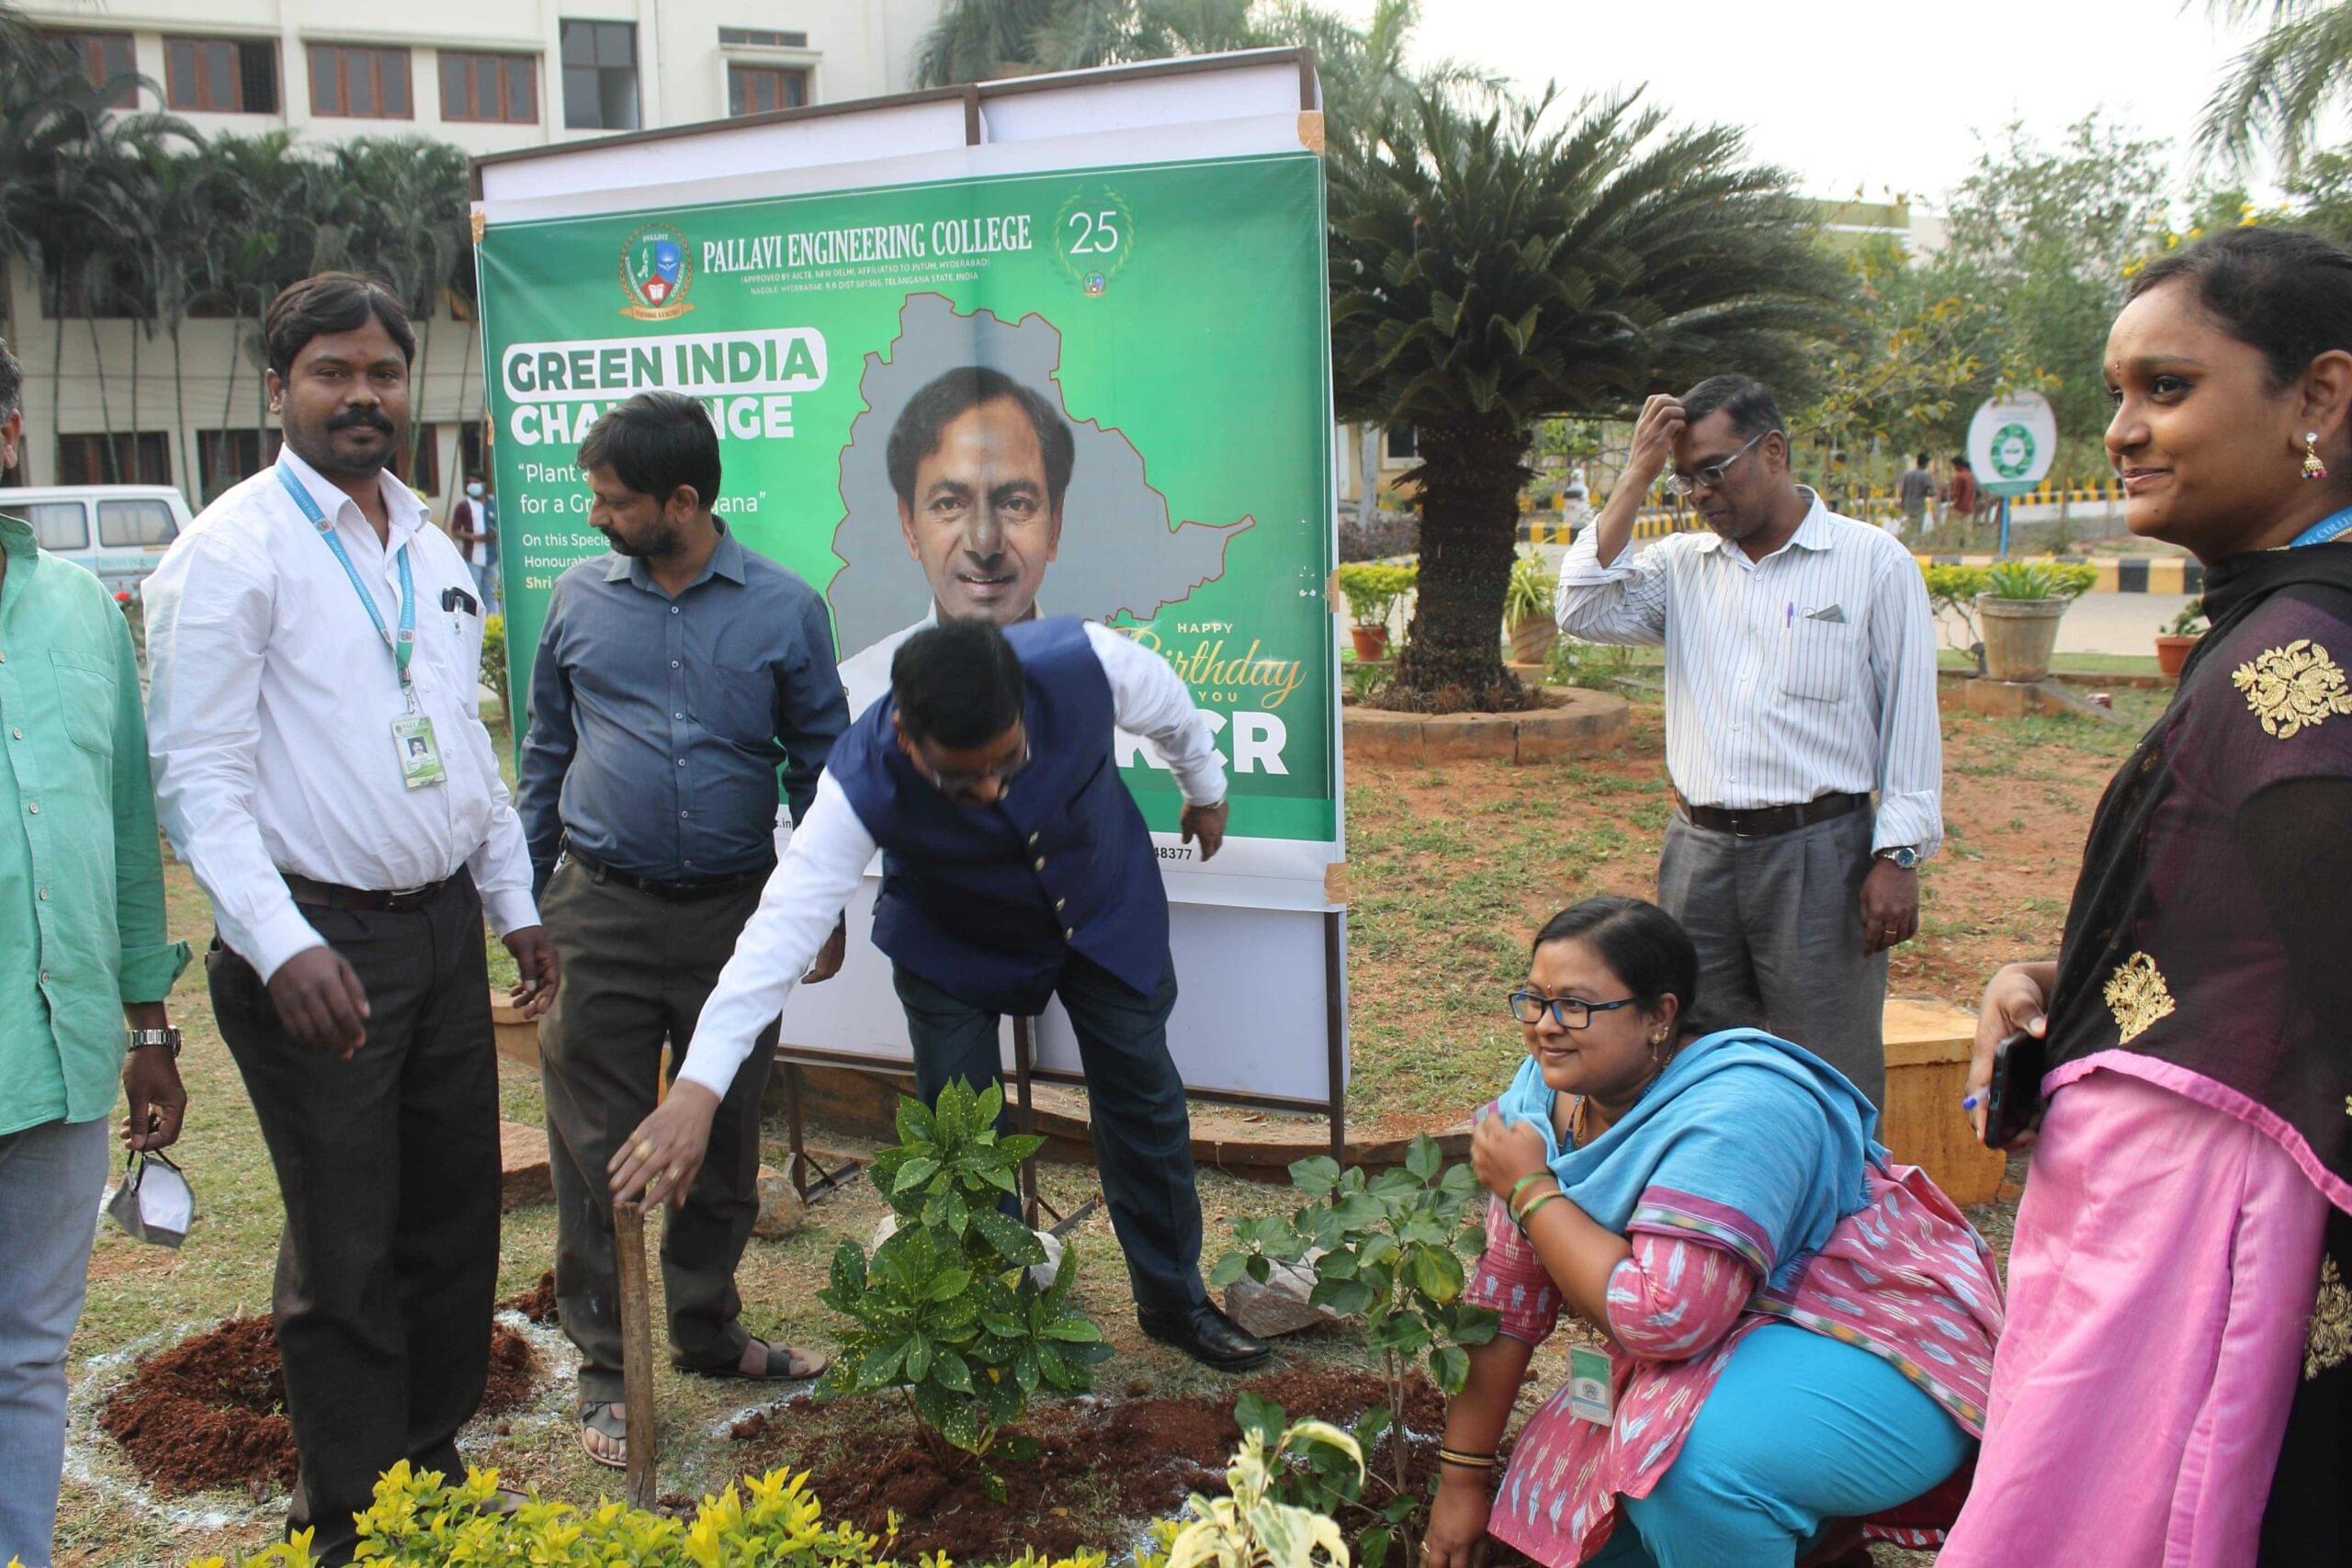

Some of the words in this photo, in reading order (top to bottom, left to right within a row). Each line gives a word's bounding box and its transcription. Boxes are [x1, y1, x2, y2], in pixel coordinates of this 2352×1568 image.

[1069, 210, 1118, 254] 25
[703, 235, 783, 274] PALLAVI
[787, 223, 926, 267] ENGINEERING
[932, 214, 1033, 256] COLLEGE
[781, 272, 791, 281] BY
[815, 269, 832, 278] NEW
[857, 264, 899, 276] AFFILIATED
[899, 263, 910, 273] TO
[885, 275, 930, 287] TELANGANA
[956, 272, 979, 281] INDIA
[507, 345, 664, 393] GREEN
[675, 337, 820, 386] INDIA
[520, 493, 548, 514] for
[553, 498, 564, 513] a
[2315, 513, 2352, 538] COLLE
[522, 534, 541, 547] On
[544, 533, 568, 547] this
[571, 533, 611, 549] Specia
[524, 555, 589, 569] Honoura
[525, 575, 552, 590] Shri
[1177, 622, 1234, 634] HAPPY
[1197, 691, 1238, 703] YOU
[1154, 847, 1193, 861] 48377
